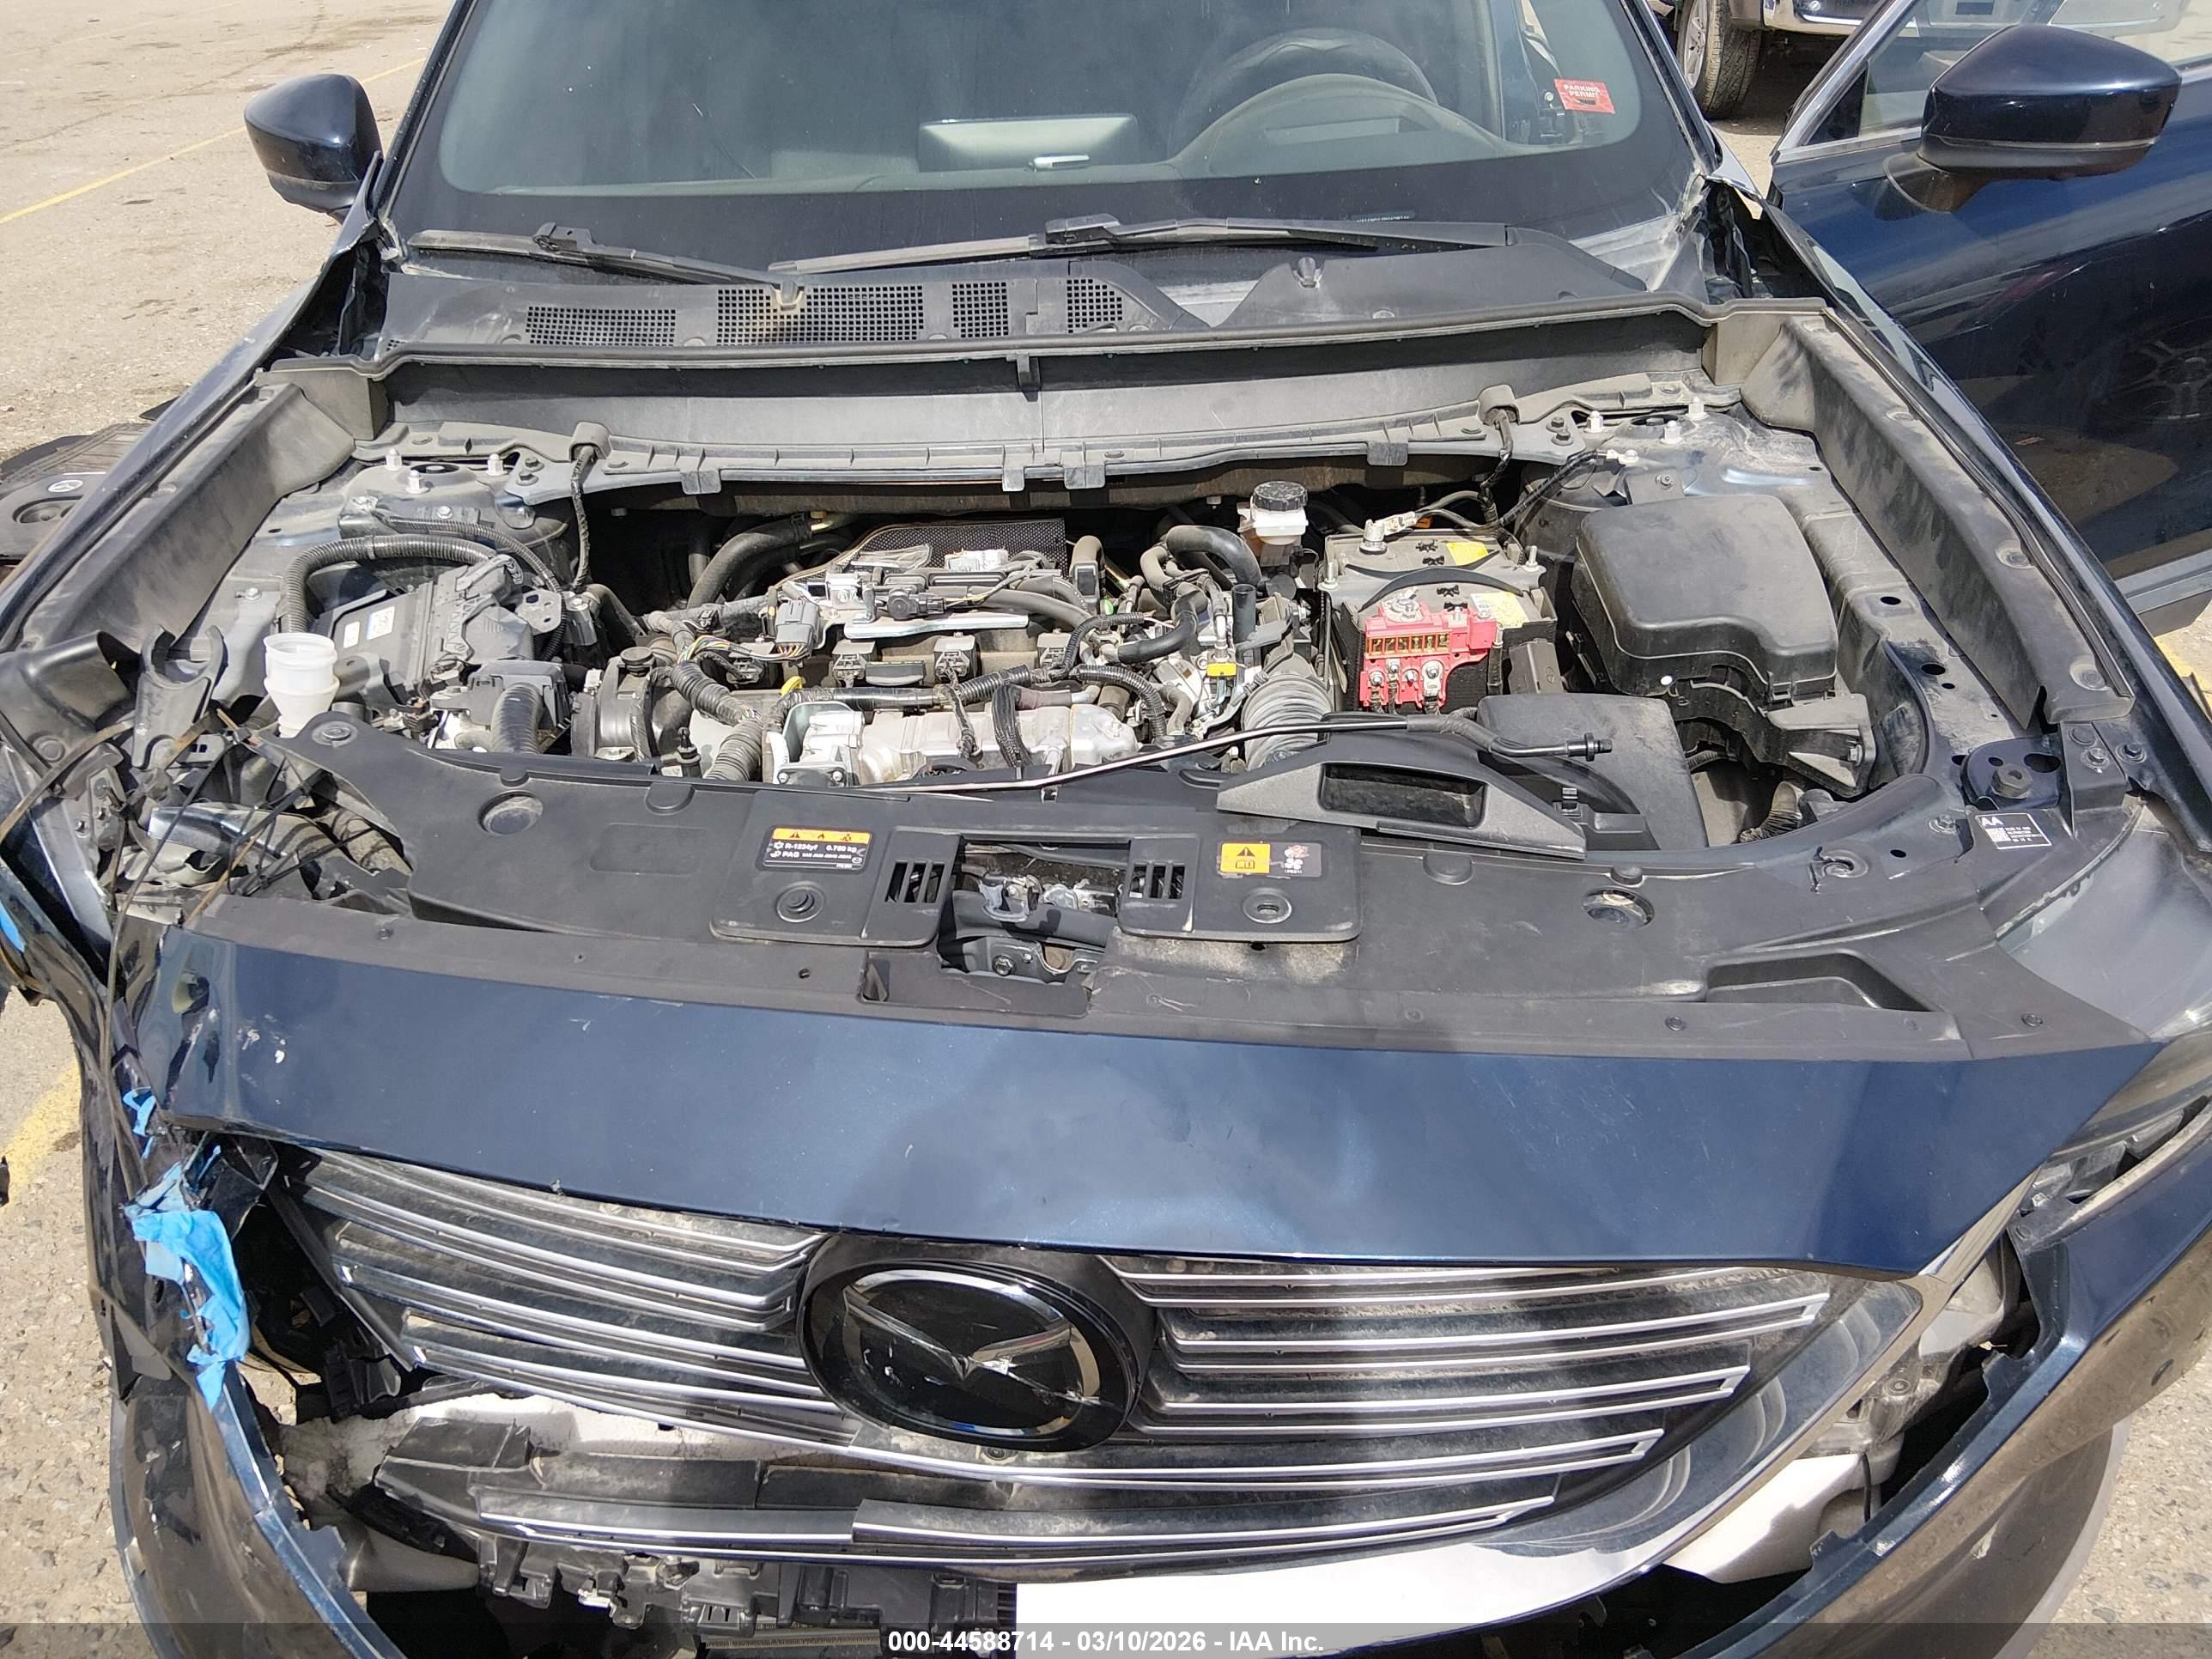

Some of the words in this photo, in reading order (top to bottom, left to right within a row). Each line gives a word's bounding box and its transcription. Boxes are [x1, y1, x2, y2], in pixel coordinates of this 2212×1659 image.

[1563, 83, 1601, 93] PARKING
[1981, 817, 2004, 826] AA
[784, 842, 818, 851] R-1234yf
